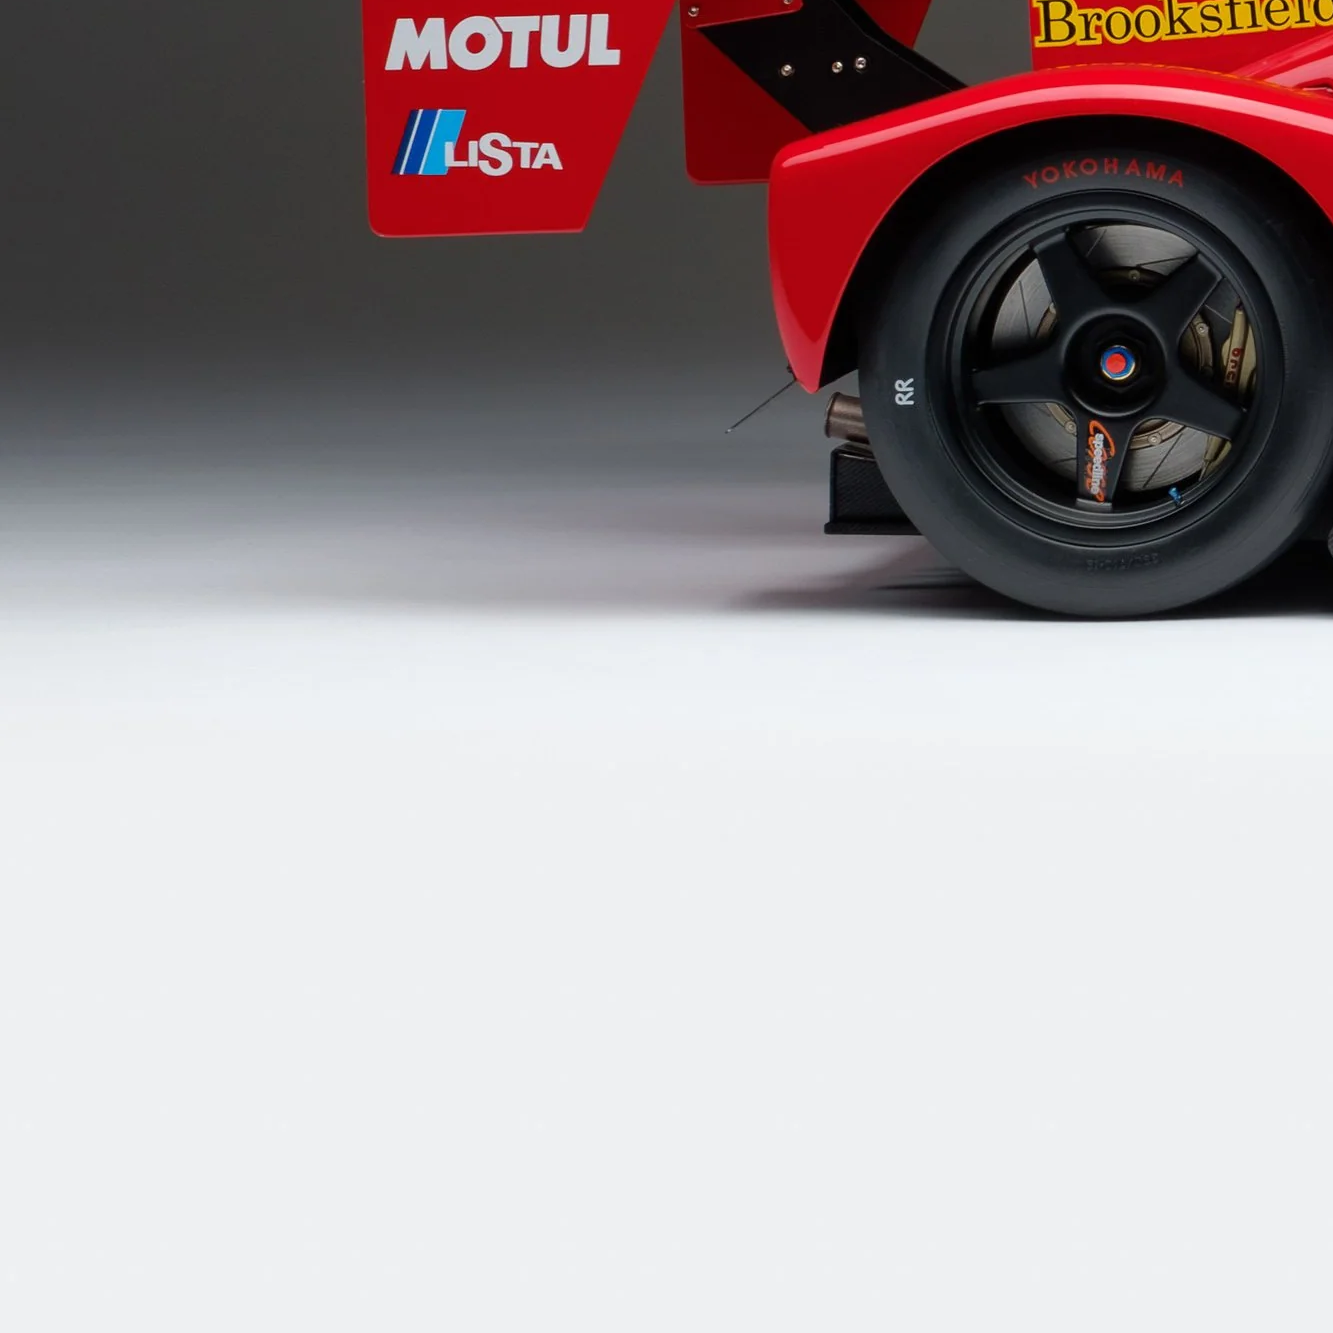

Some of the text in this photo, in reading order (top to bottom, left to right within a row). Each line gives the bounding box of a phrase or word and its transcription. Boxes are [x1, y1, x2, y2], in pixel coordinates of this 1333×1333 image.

[385, 13, 620, 70] MOTUL
[1023, 157, 1185, 191] YOKOHAMA
[895, 378, 914, 406] RR
